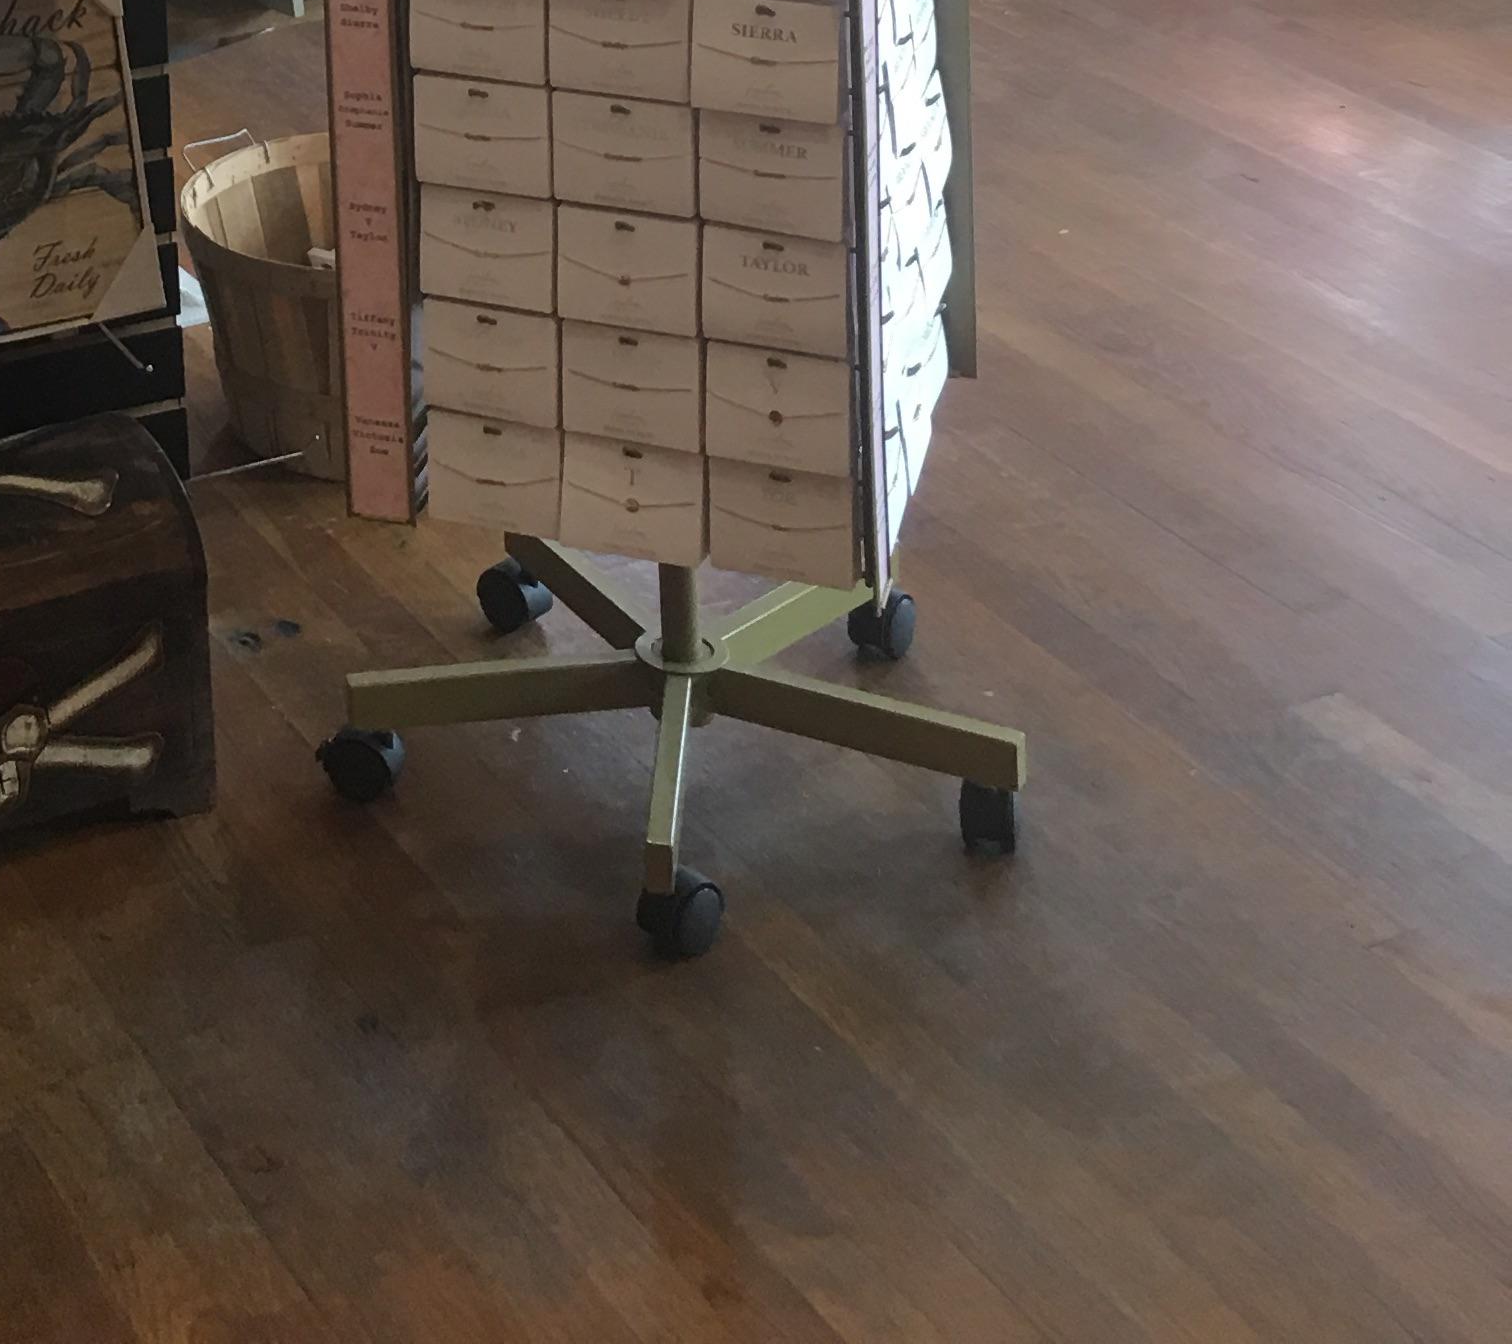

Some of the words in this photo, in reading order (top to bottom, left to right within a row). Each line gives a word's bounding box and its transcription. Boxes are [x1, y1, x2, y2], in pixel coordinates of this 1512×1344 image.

[731, 22, 798, 44] SIERRA
[33, 235, 97, 272] Fresh
[740, 255, 810, 277] TAYLOR
[30, 270, 99, 301] Daily
